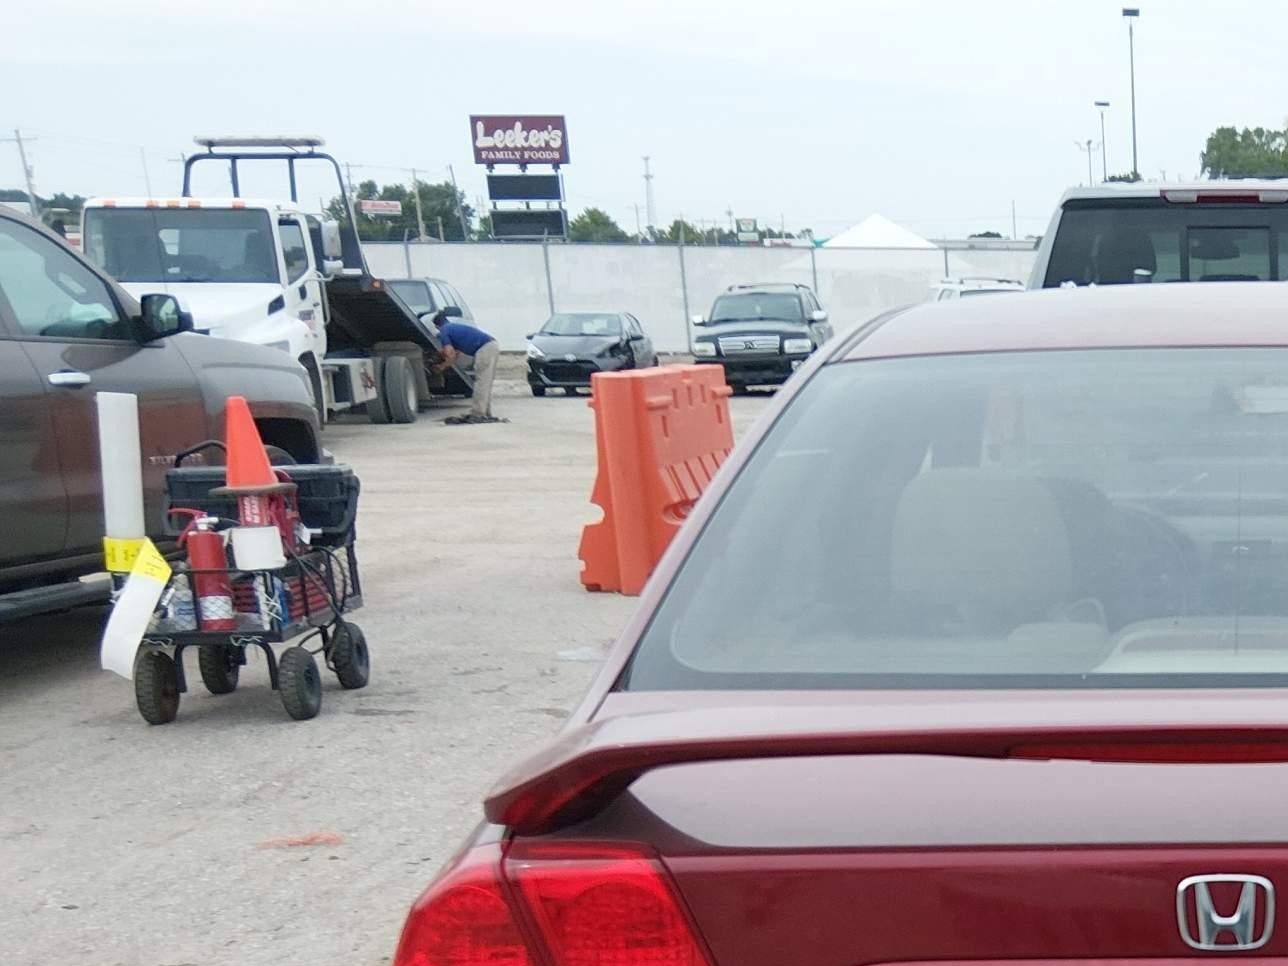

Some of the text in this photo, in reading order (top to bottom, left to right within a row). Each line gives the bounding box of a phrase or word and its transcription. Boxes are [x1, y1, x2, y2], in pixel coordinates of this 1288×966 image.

[475, 120, 562, 148] Leeker's
[481, 150, 560, 159] FAMILY FOODS
